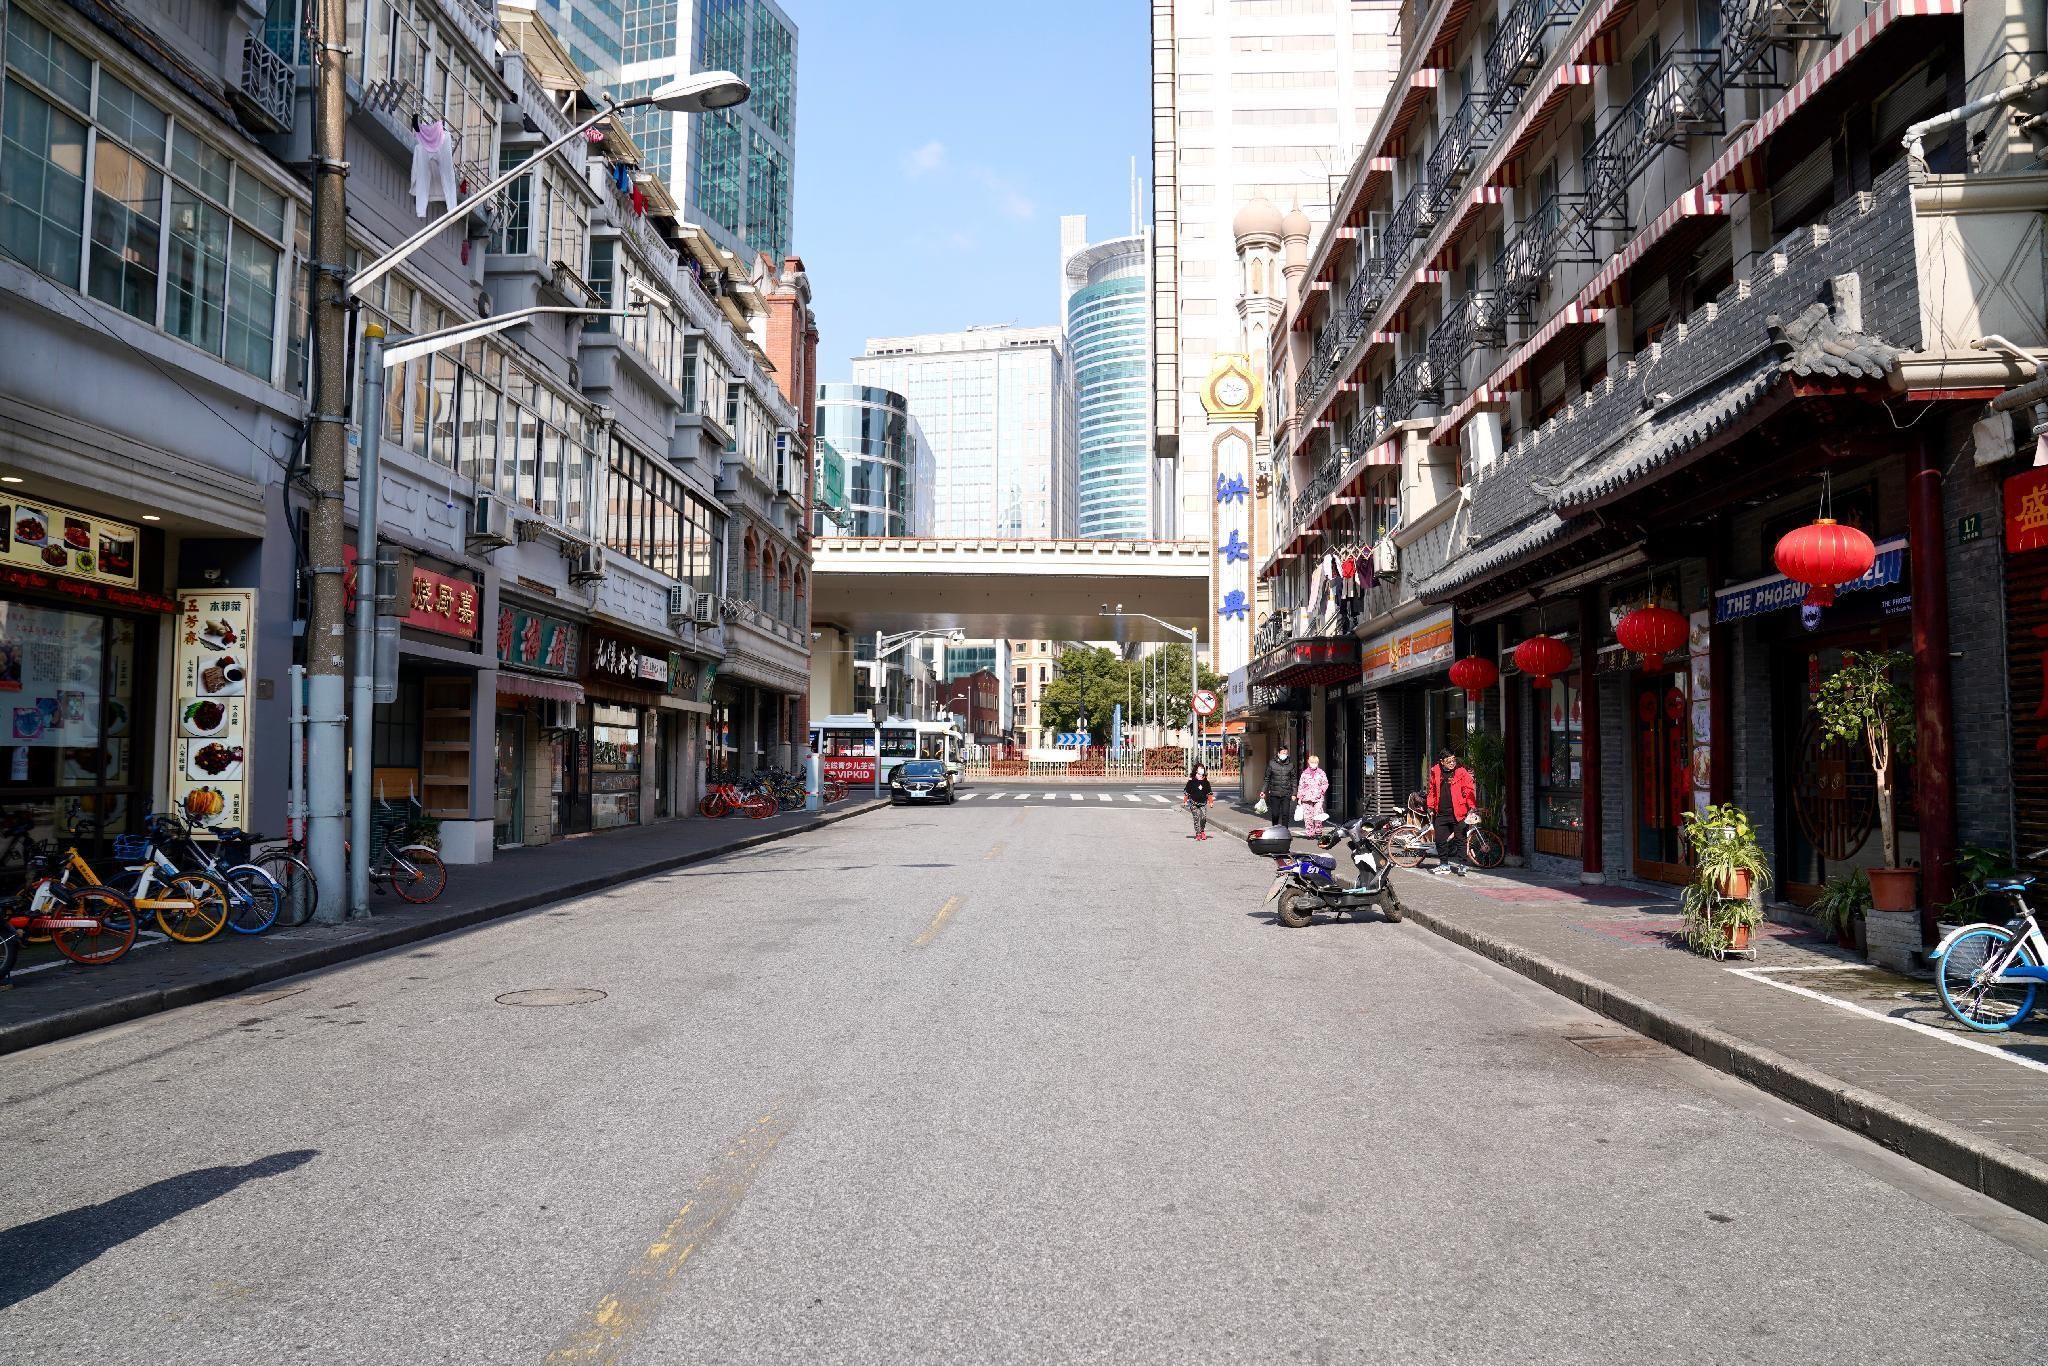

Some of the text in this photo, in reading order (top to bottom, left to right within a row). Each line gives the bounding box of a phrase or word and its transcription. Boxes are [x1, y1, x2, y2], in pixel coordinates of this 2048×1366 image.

[1726, 594, 1751, 615] THE
[1755, 581, 1811, 608] PHOENI
[837, 770, 870, 779] VIPKID
